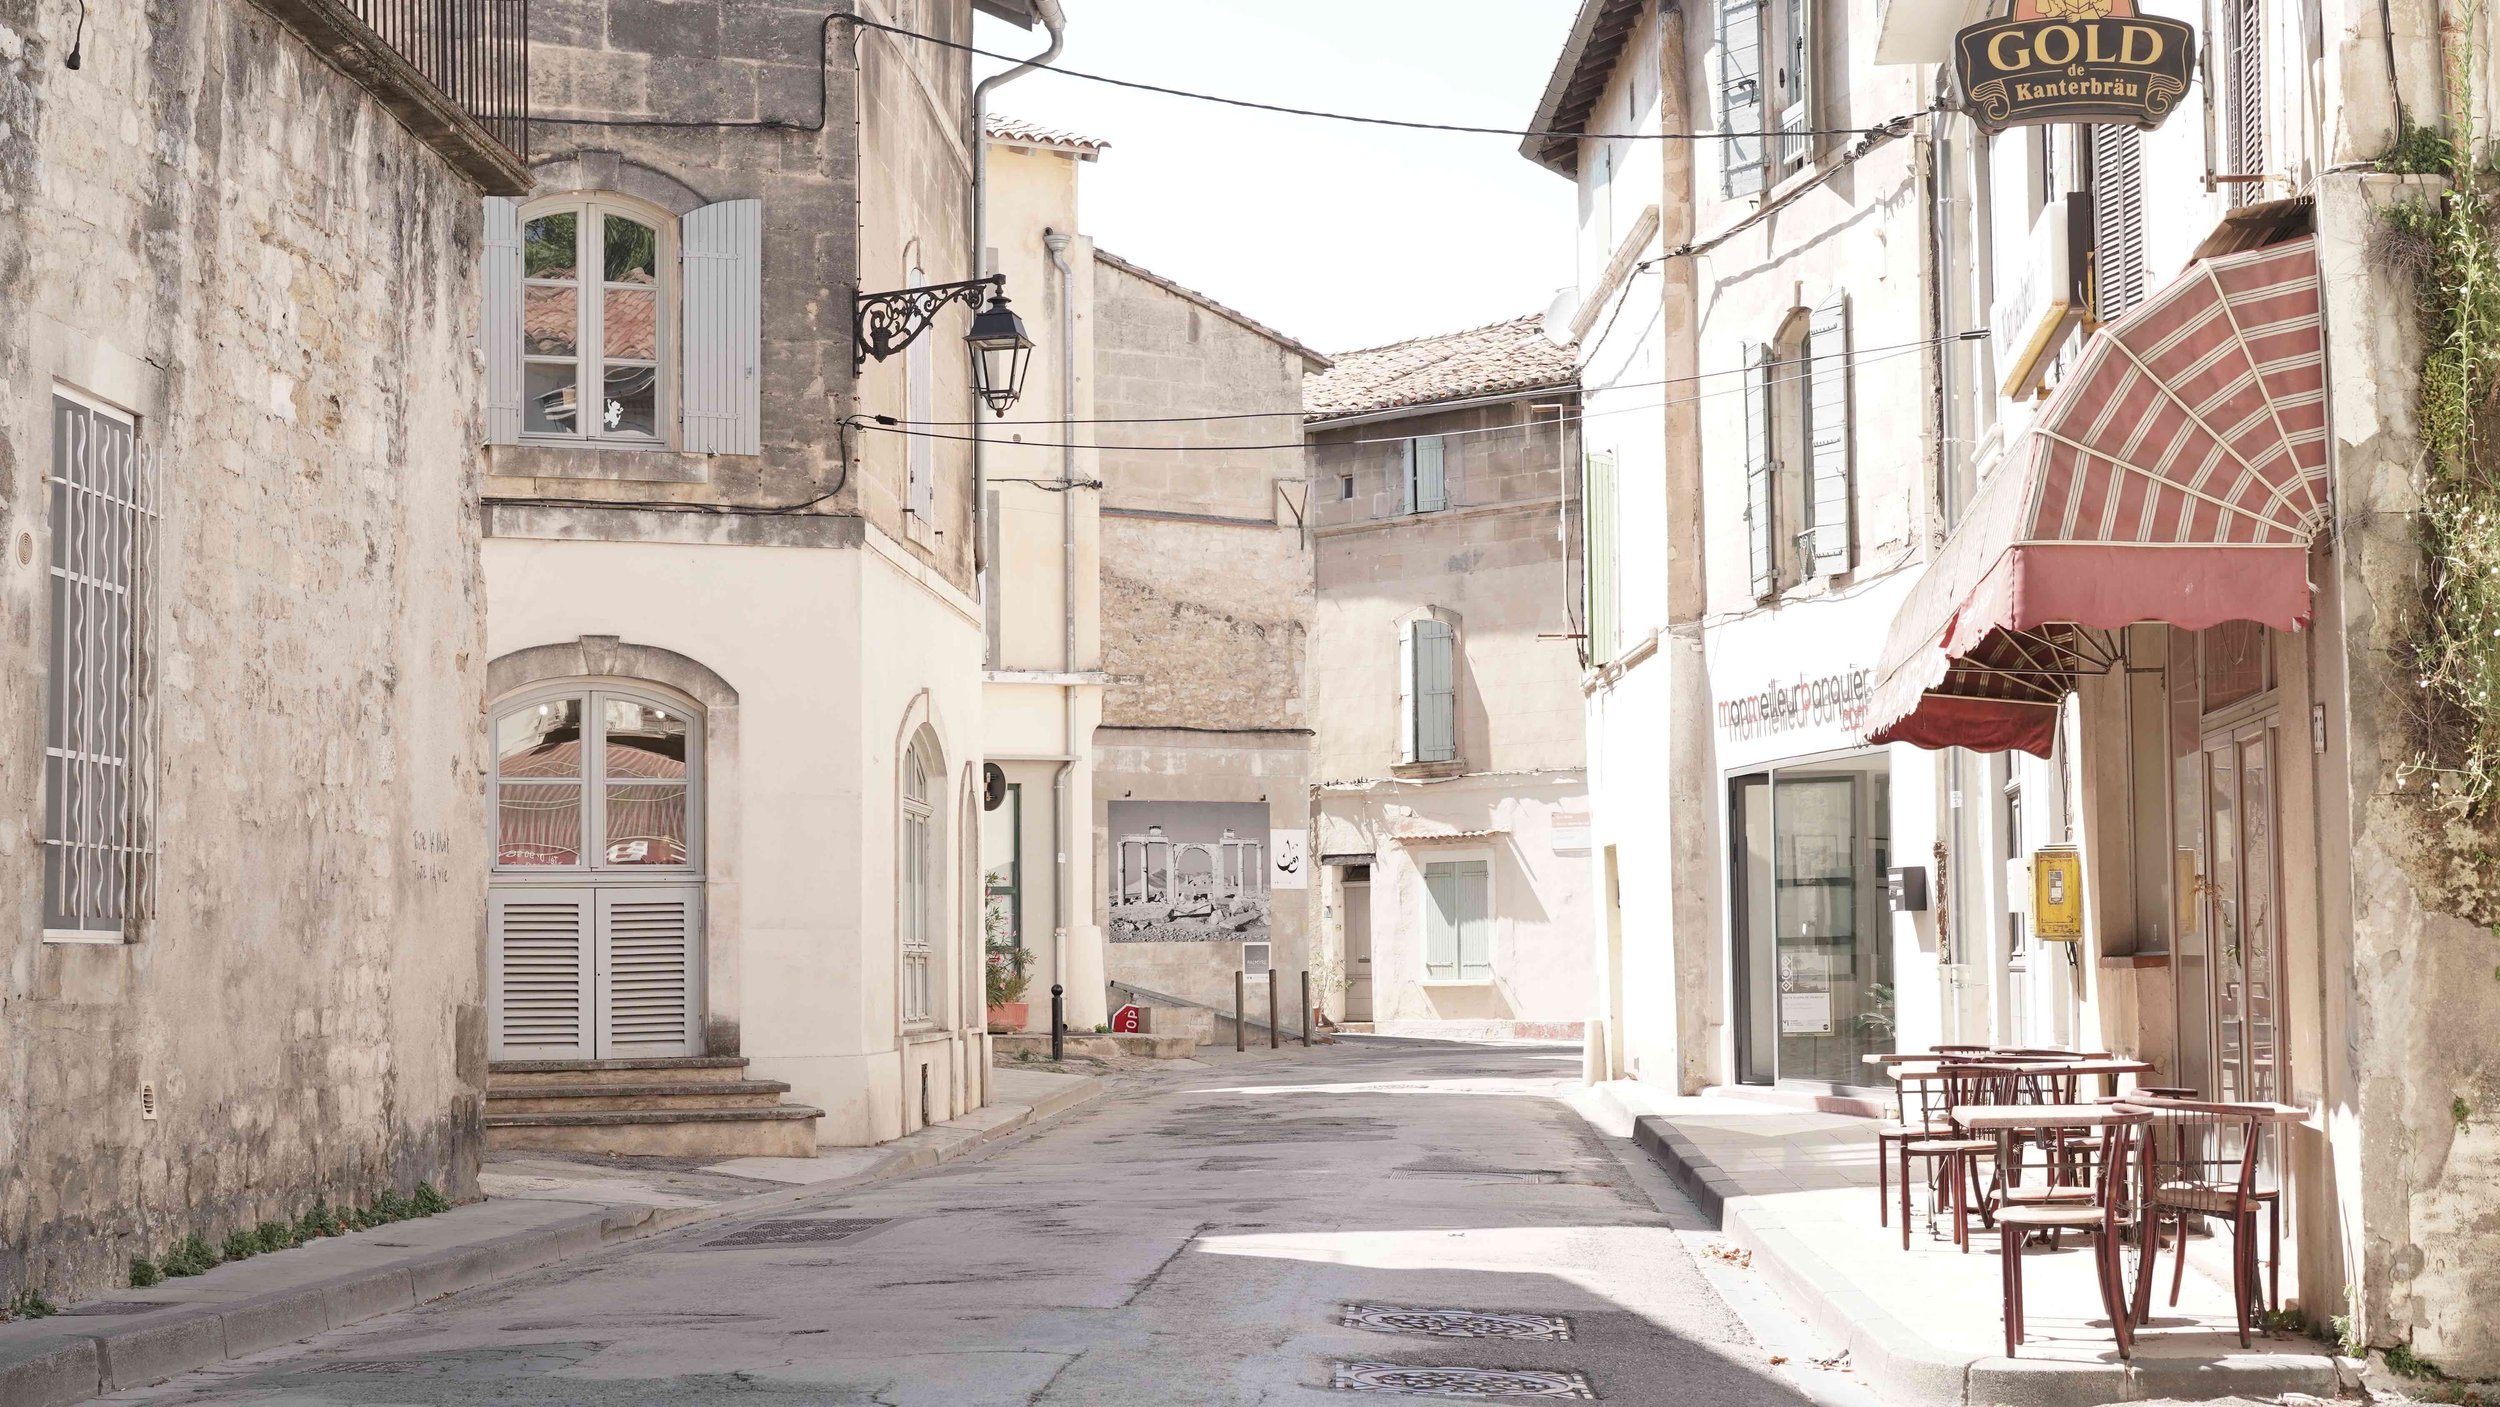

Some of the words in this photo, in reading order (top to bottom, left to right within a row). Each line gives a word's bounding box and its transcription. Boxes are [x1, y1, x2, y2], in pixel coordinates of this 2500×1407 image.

[1987, 24, 2163, 71] GOLD
[2067, 64, 2085, 77] de
[2015, 78, 2138, 101] Kanterbräu
